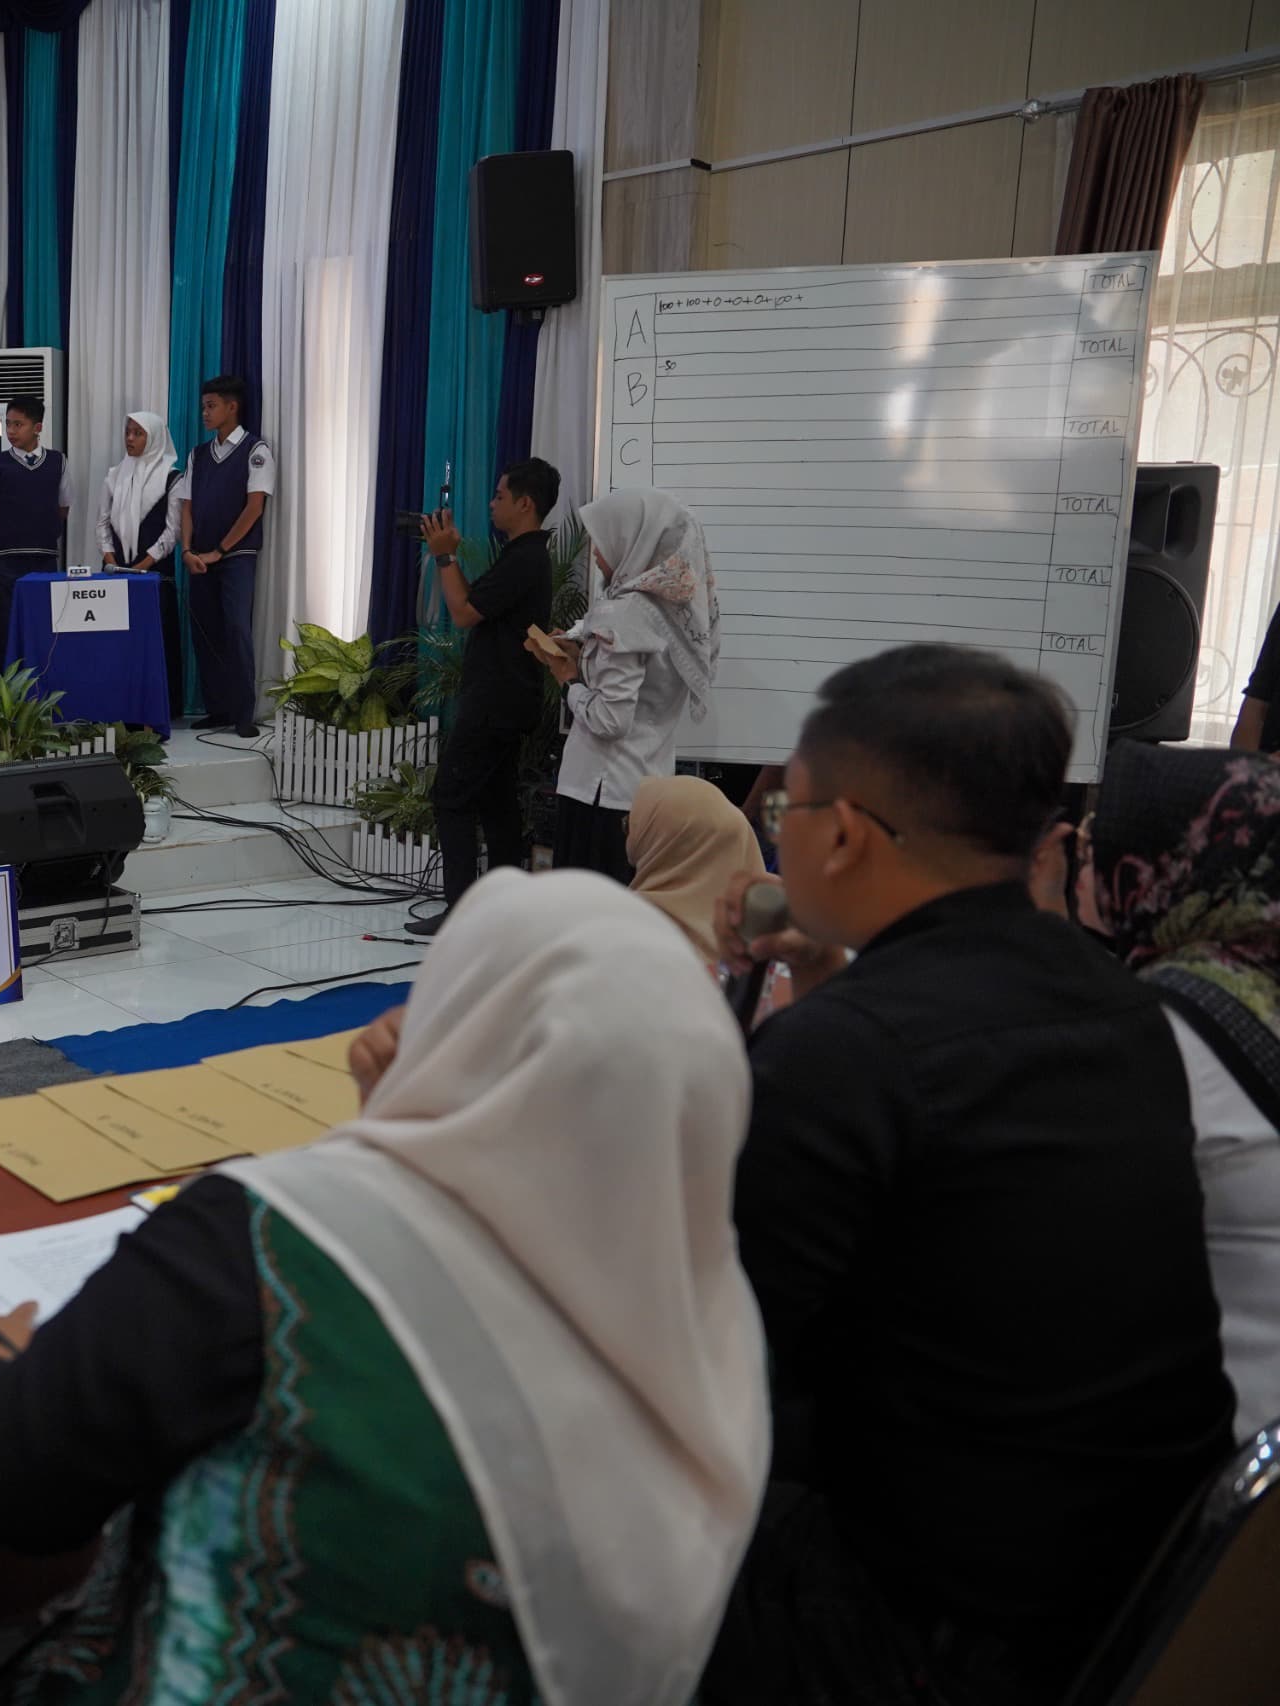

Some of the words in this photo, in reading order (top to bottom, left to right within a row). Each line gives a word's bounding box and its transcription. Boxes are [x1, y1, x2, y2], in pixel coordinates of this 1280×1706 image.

[1089, 273, 1136, 290] TOTAL
[626, 308, 647, 349] A
[1080, 338, 1129, 354] TOTAL
[627, 371, 648, 407] B
[1068, 420, 1120, 435] TOTAL
[619, 438, 641, 466] C
[1061, 496, 1114, 512] TOTAL
[1056, 567, 1111, 585] TOTAL
[72, 588, 106, 600] REGU
[84, 610, 96, 622] A
[1045, 633, 1098, 651] TOTAL
